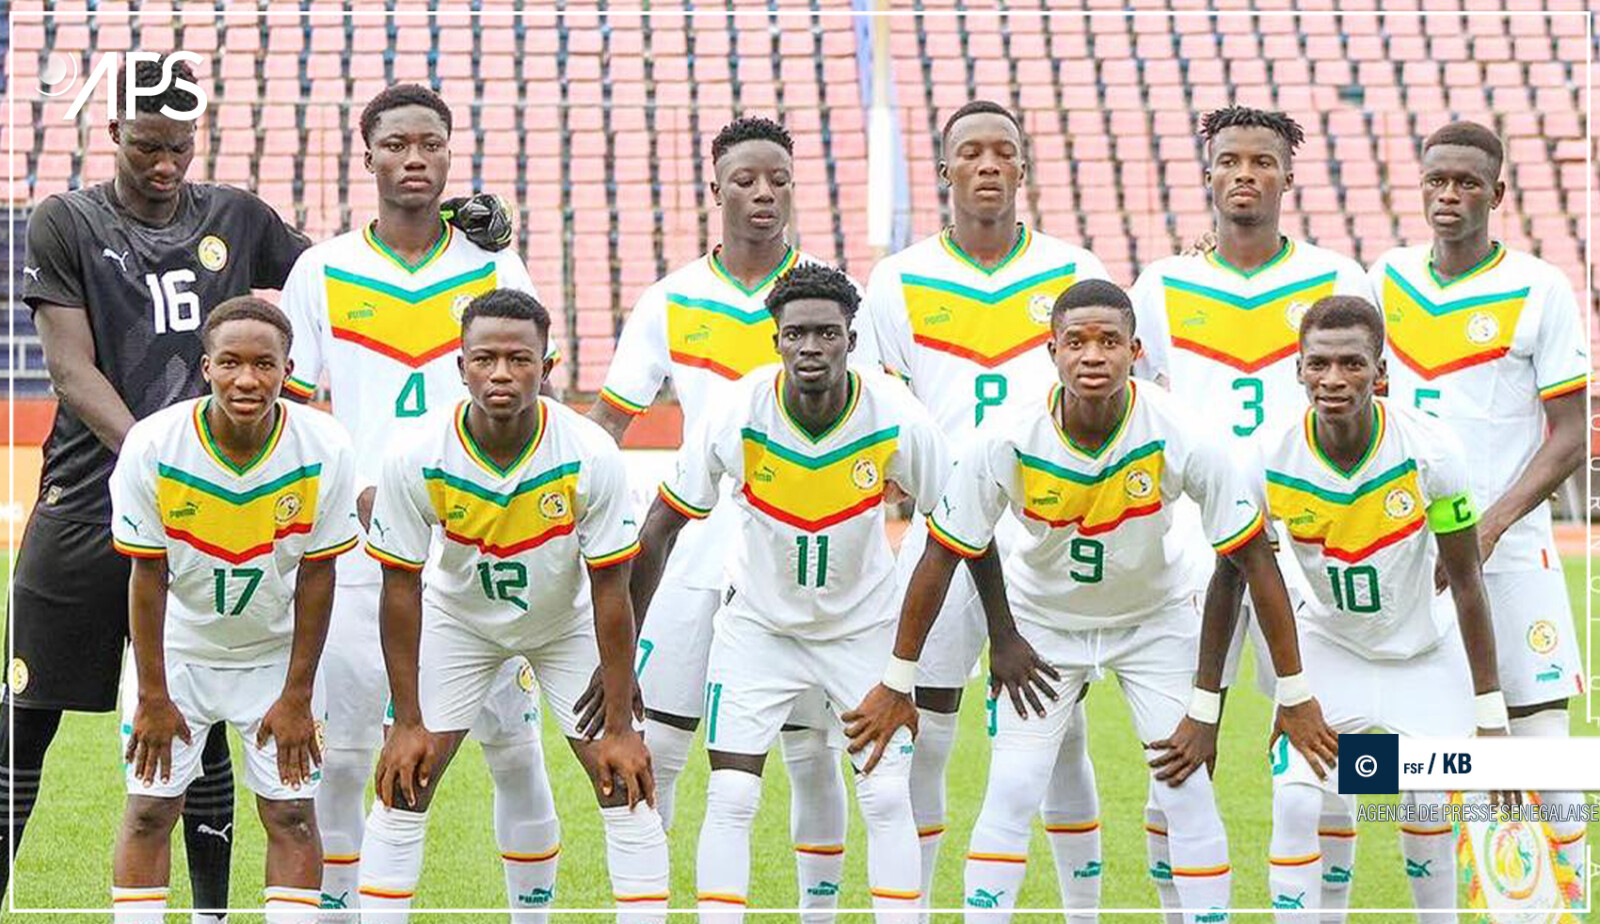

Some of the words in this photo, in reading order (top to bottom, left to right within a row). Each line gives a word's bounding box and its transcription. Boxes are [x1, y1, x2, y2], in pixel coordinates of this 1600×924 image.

[144, 269, 200, 334] 16
[395, 372, 427, 417] 4
[1232, 378, 1264, 437] 3
[1453, 497, 1472, 523] C
[796, 535, 829, 587] 11
[1070, 537, 1104, 583] 9
[213, 567, 264, 616] 17
[477, 561, 528, 611] 12
[1327, 565, 1381, 612] 10
